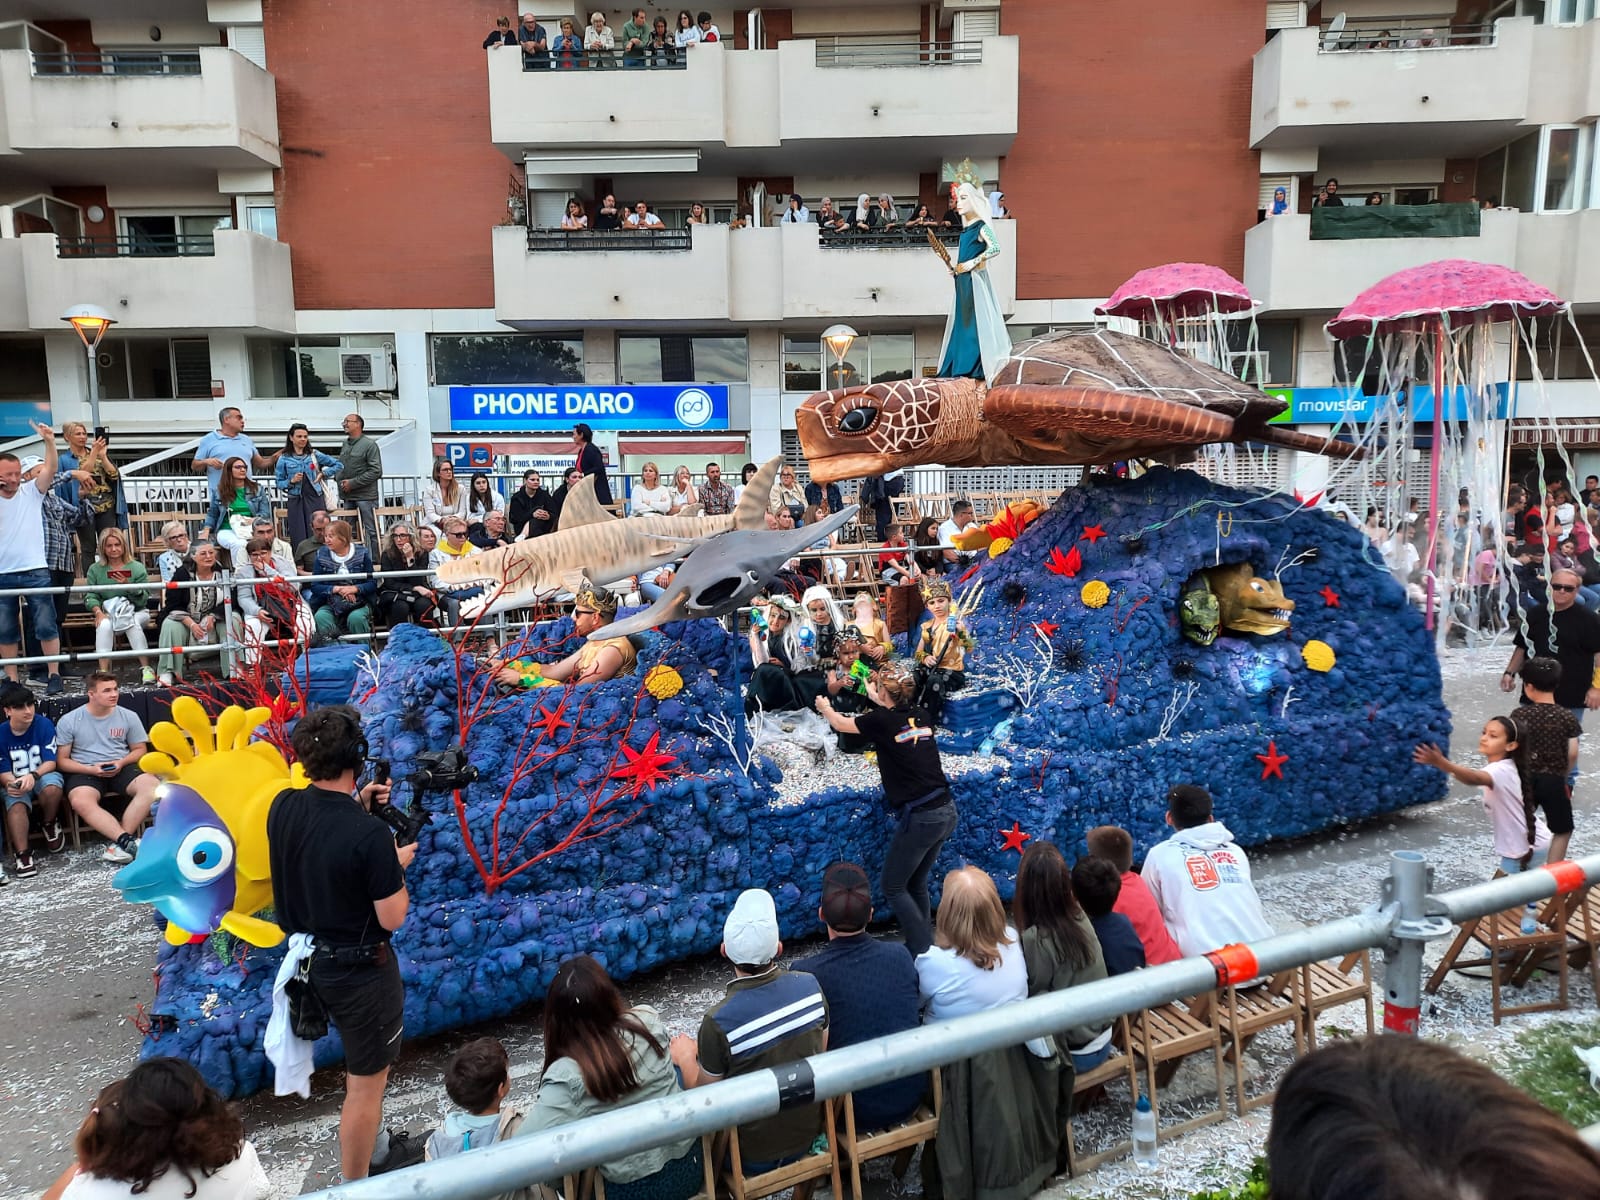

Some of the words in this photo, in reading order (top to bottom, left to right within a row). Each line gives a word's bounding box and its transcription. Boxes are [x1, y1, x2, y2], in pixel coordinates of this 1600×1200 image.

[473, 393, 558, 414] PHONE
[565, 392, 634, 414] DARO
[1298, 400, 1368, 412] movistar
[450, 444, 466, 466] P
[532, 459, 553, 468] SMART
[145, 488, 194, 500] CAMP
[9, 744, 43, 776] 26
